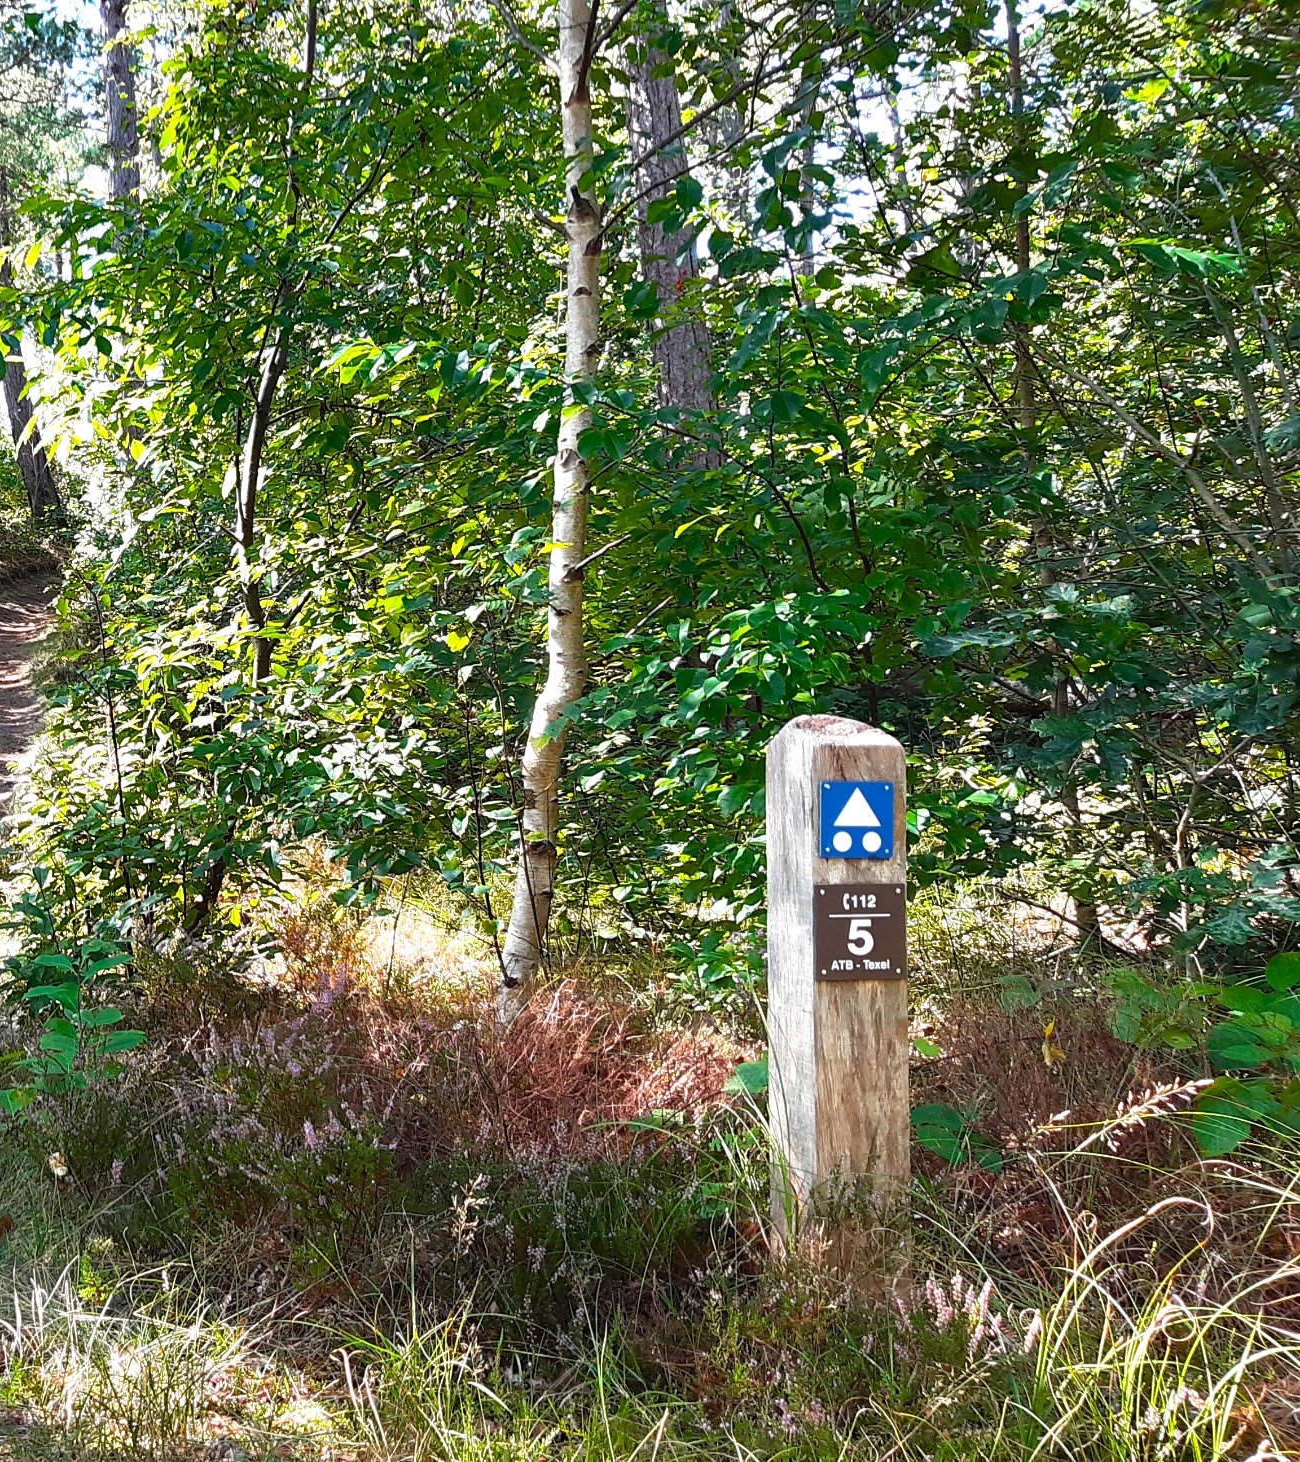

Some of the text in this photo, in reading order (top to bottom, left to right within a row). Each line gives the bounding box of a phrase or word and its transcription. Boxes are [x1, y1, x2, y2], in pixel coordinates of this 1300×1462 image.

[851, 894, 877, 908] 112
[847, 919, 874, 956] 5
[831, 959, 854, 970] ATB
[863, 959, 890, 970] Texel
